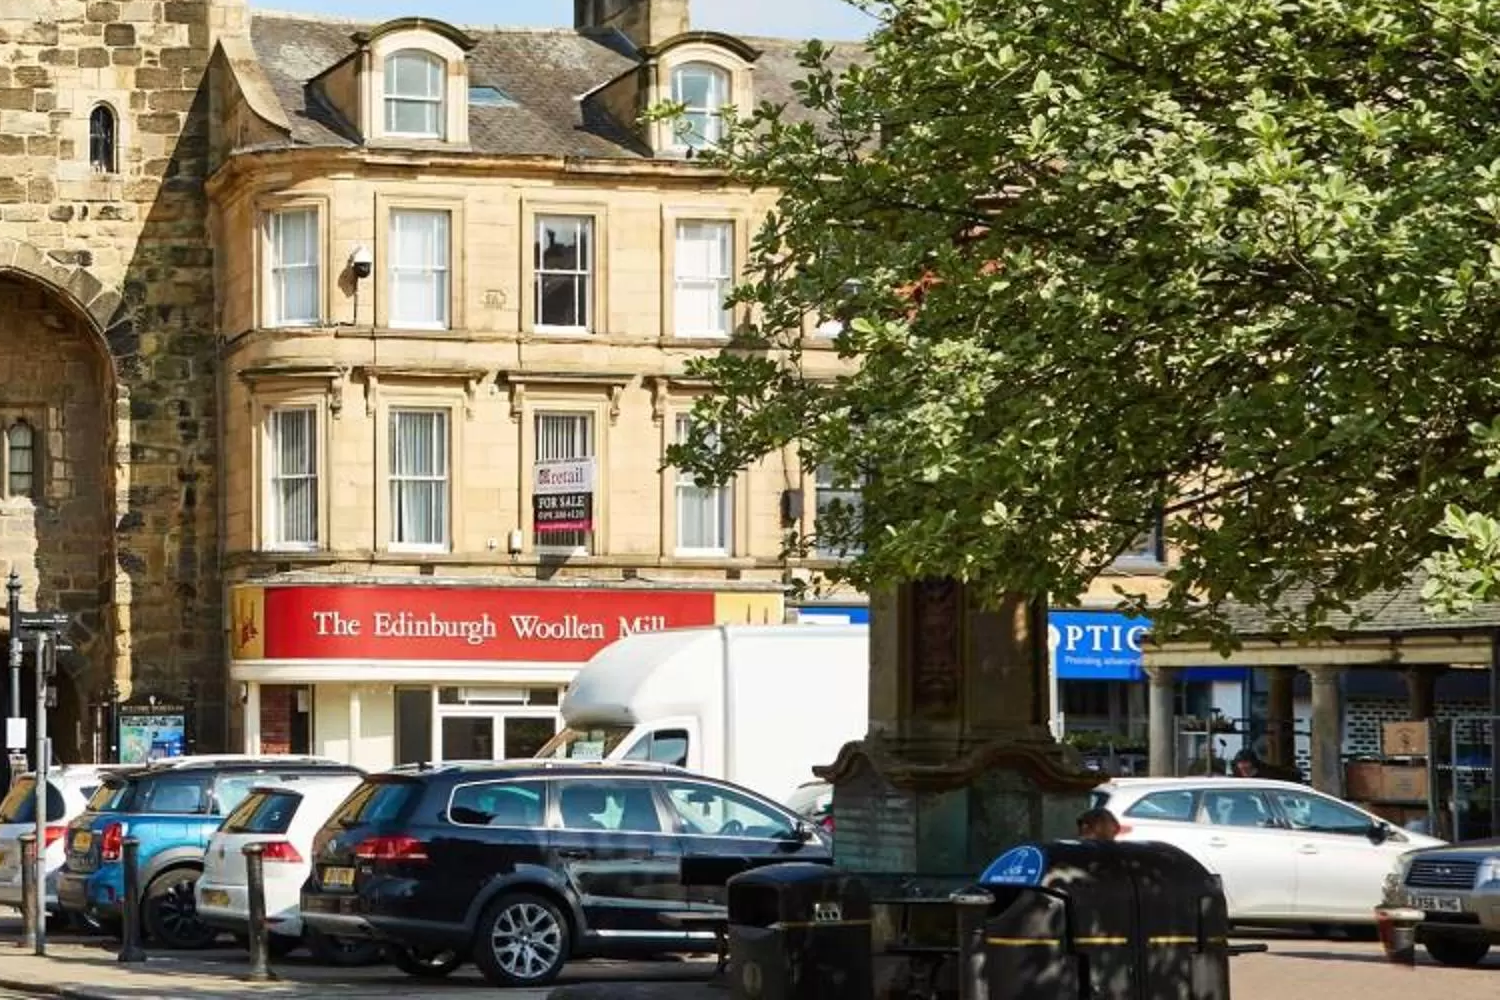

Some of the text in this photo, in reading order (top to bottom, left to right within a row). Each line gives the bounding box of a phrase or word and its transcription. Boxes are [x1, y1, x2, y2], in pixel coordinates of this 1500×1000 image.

[538, 495, 585, 509] FOR SALE
[313, 611, 666, 645] The Edinburgh Woollen Mill
